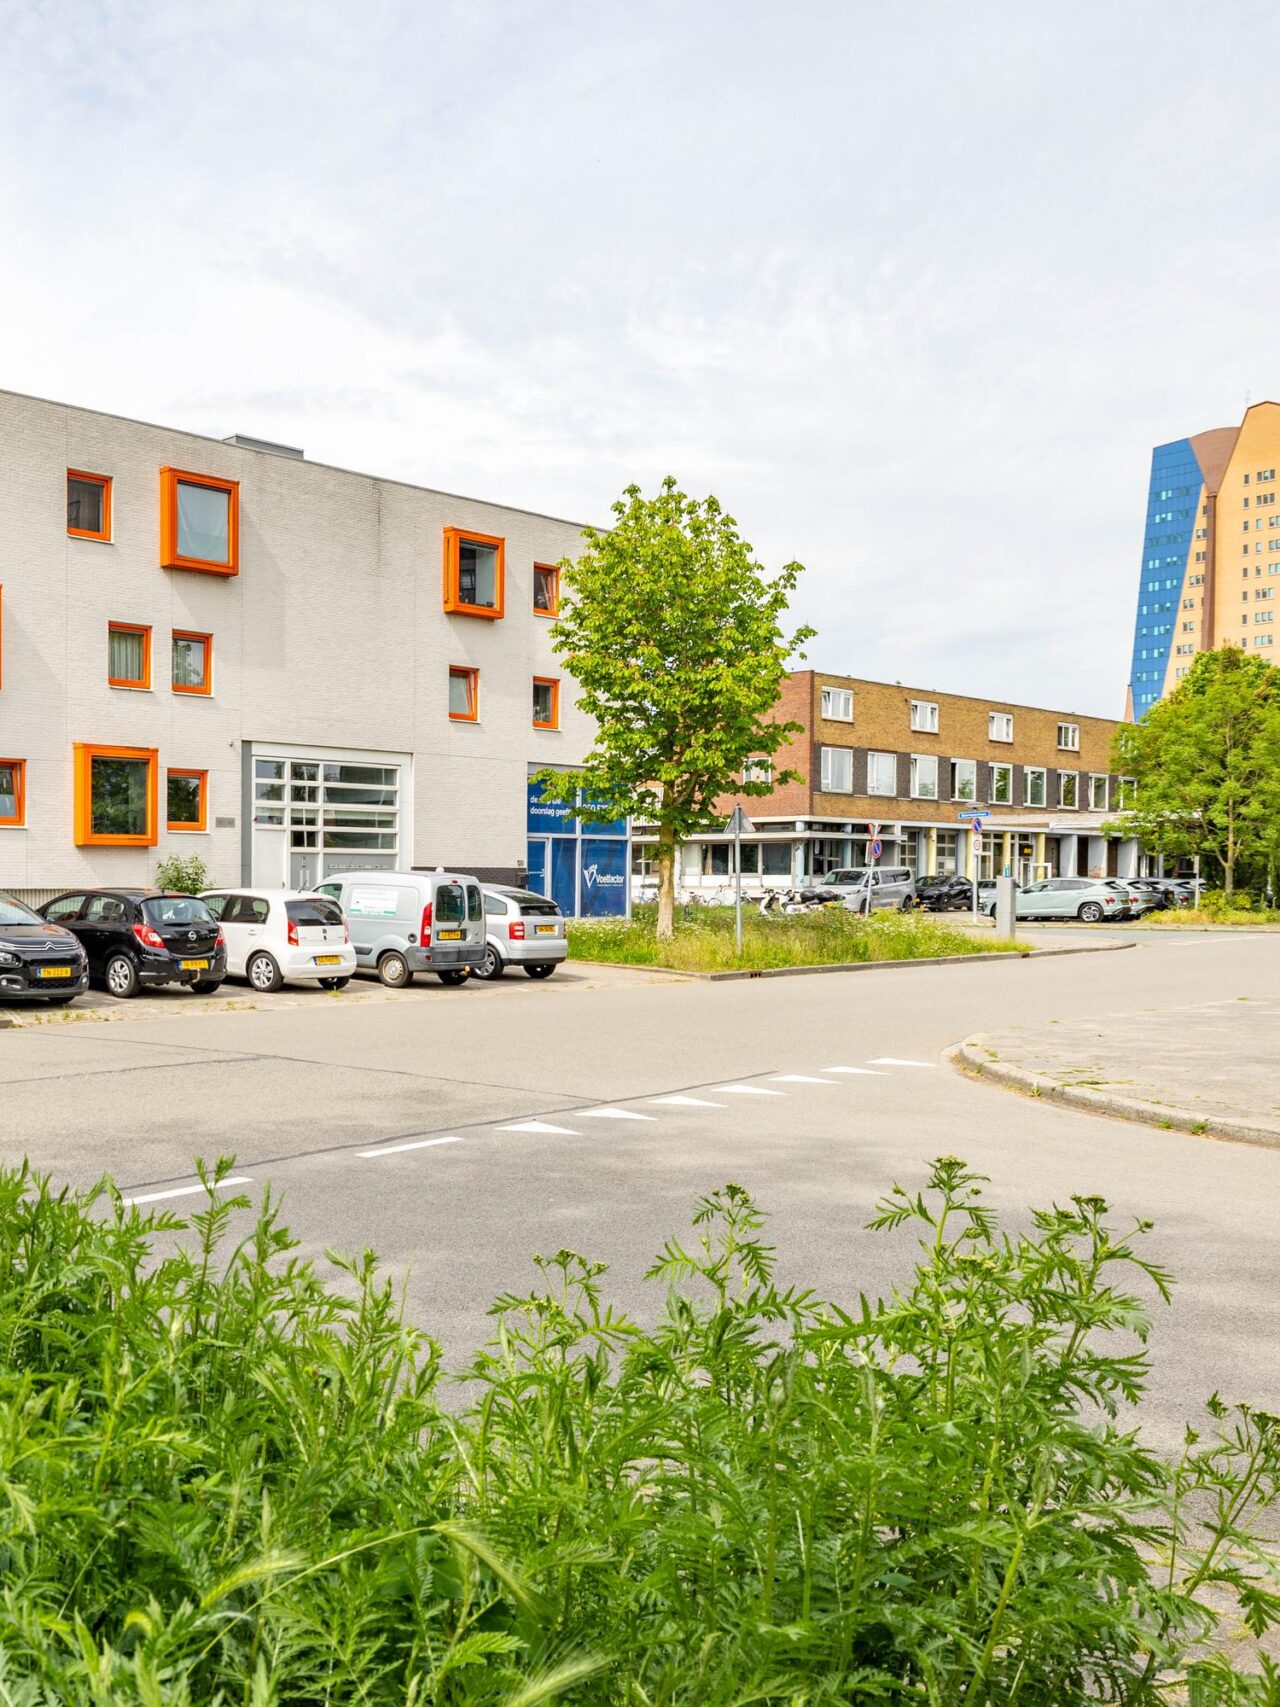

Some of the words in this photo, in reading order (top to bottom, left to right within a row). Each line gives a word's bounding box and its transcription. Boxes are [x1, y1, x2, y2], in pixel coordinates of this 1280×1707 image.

[530, 795, 538, 803] de
[530, 806, 555, 817] doorslag
[595, 874, 624, 884] Voetfactor
